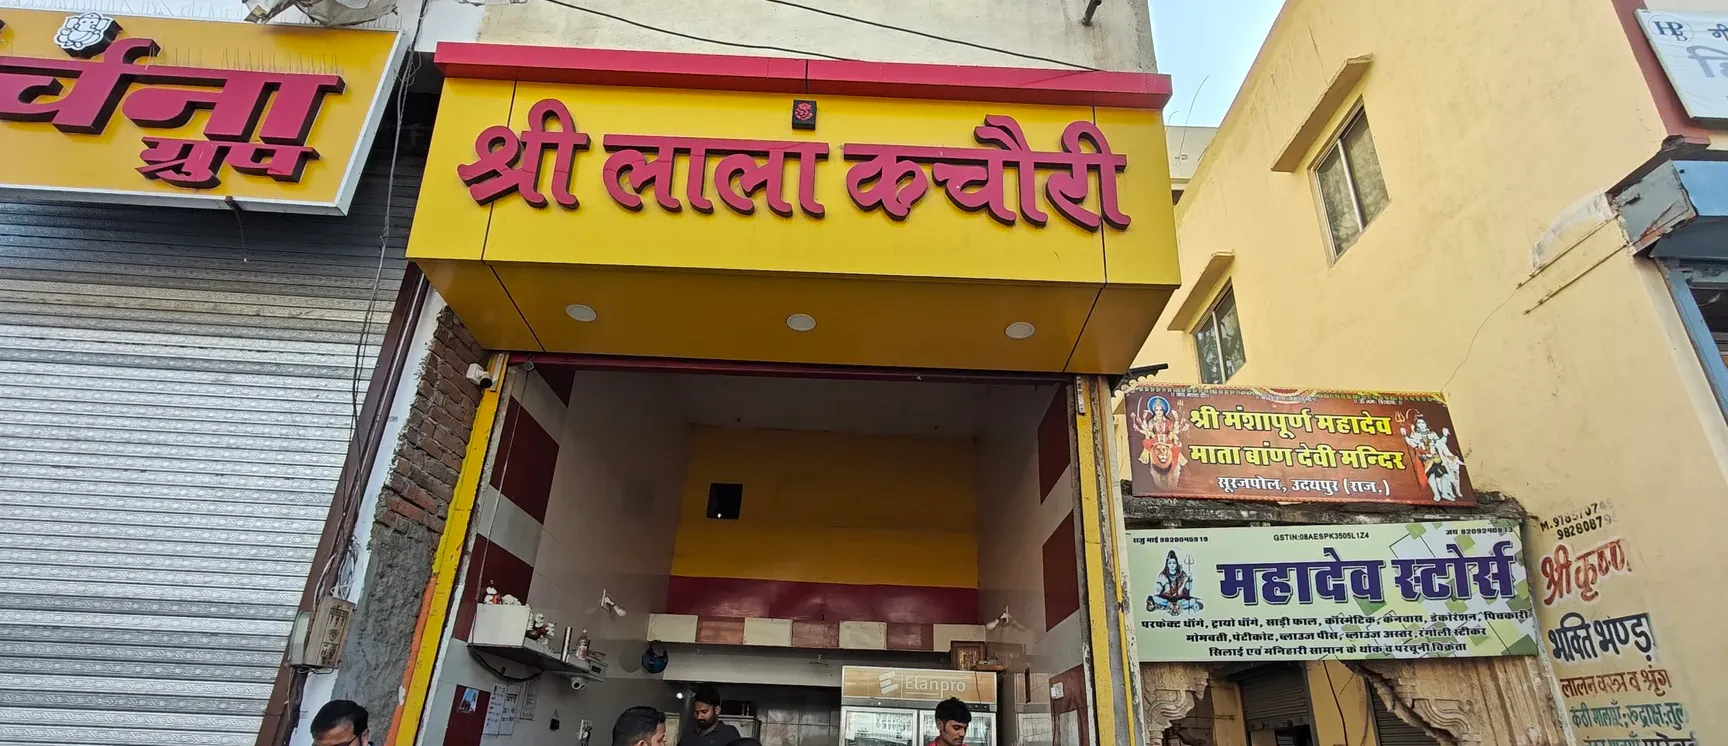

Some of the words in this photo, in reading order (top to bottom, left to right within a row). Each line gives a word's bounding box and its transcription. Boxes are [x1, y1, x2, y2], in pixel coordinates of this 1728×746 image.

[135, 136, 321, 189] ग्रुप
[457, 98, 590, 210] श्री
[603, 133, 830, 218] लाला
[843, 114, 1131, 232] कचौरी
[1189, 405, 1219, 430] श्री
[1223, 406, 1312, 439] मंशापूर्ण
[1316, 410, 1392, 436] महादेव
[1189, 443, 1241, 465] माता
[1245, 441, 1294, 467] बांण
[1296, 443, 1337, 469] देवी
[1340, 446, 1406, 471] मन्दिर
[1291, 477, 1339, 493] उदयपुर
[1344, 478, 1390, 496] (राज.)
[1216, 547, 1385, 606] महादेव
[1391, 541, 1517, 600] स्टोर्स
[1541, 544, 1572, 605] श्री
[1265, 617, 1290, 629] साड़ी
[1548, 612, 1598, 662] भक्ति
[1209, 647, 1243, 657] सिलाई
[1246, 646, 1263, 656] एवं
[1264, 646, 1307, 655] मनिहारी
[1309, 644, 1343, 655] सामान
[1346, 644, 1357, 654] के
[1359, 643, 1382, 653] थोक
[1385, 645, 1392, 653] व
[1395, 643, 1430, 654] परचूनी
[1432, 642, 1467, 652] विक्रेता
[905, 675, 966, 699] Elanpro
